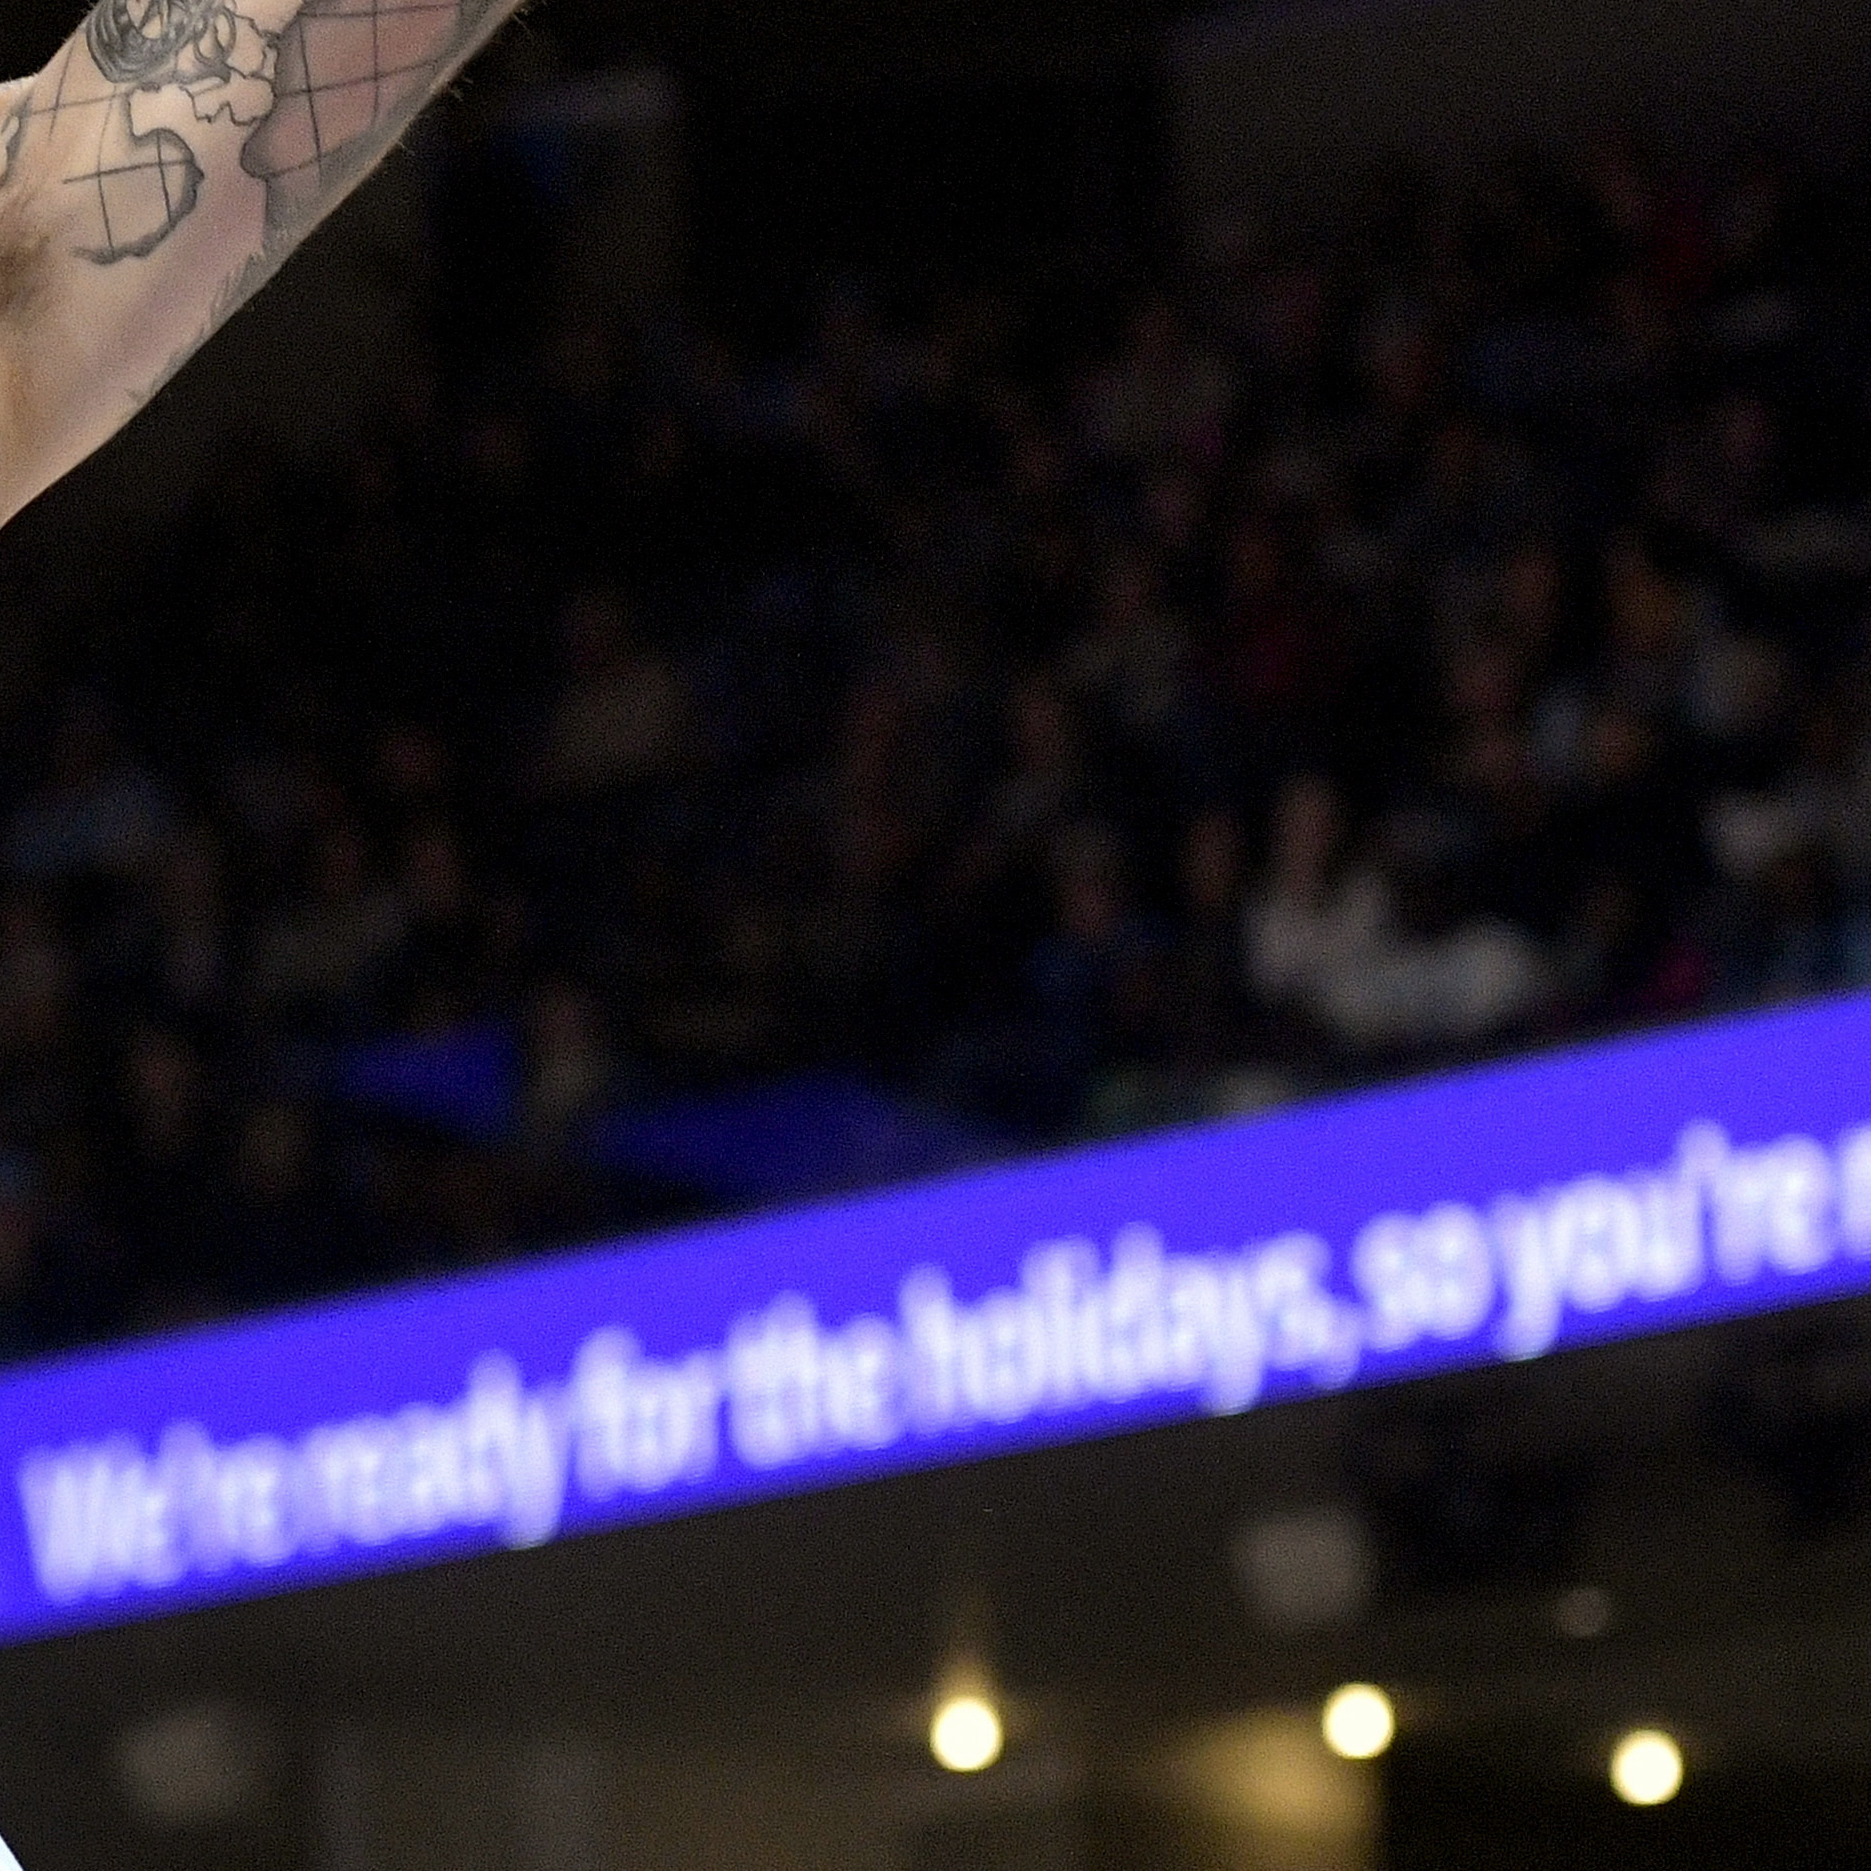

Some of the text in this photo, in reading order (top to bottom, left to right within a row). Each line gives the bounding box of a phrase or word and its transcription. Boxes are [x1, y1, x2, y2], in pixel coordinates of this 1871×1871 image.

[297, 1349, 569, 1550] ready
[570, 1324, 722, 1501] for
[722, 1289, 904, 1469] the
